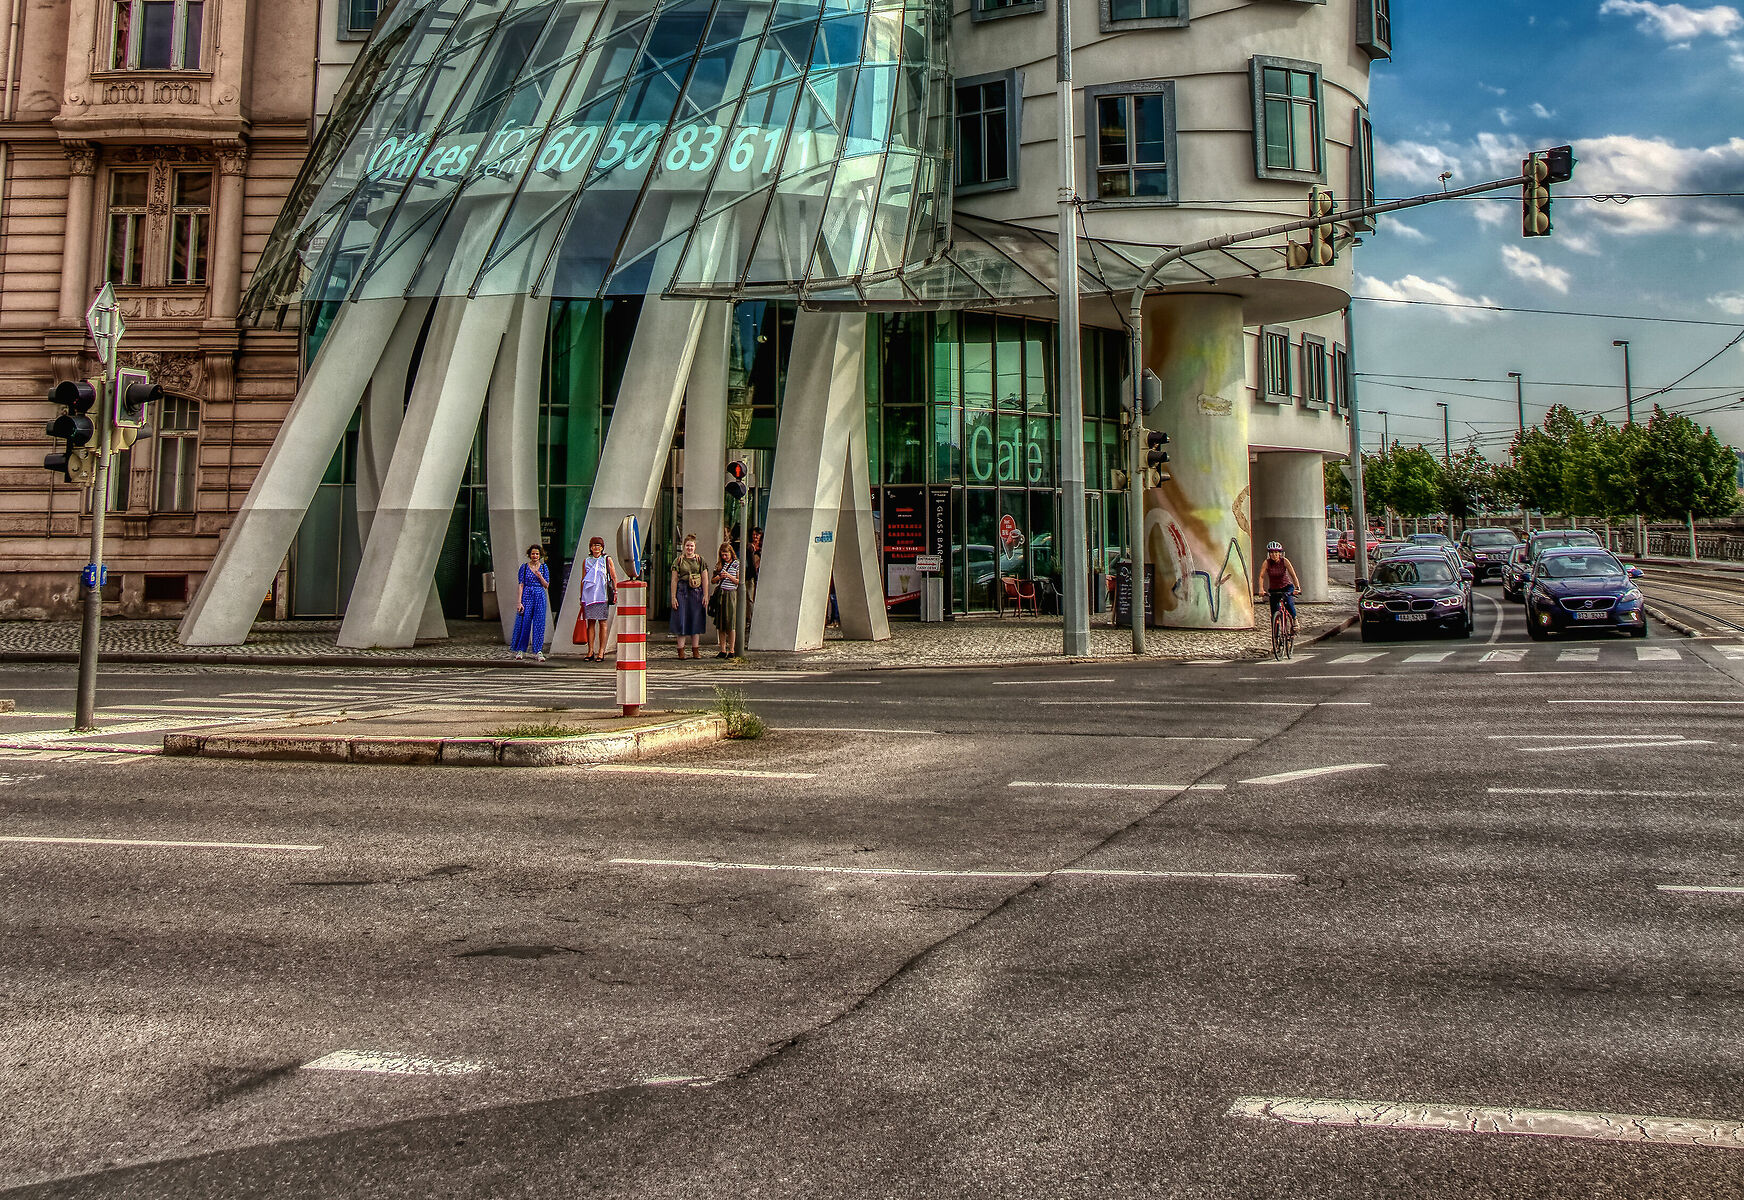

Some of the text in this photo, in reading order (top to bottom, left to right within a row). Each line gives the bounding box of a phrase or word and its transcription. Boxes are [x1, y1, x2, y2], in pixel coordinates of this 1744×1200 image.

[365, 132, 478, 183] Offices
[486, 119, 544, 155] for
[534, 125, 599, 173] 60
[596, 123, 661, 171] 50
[665, 124, 723, 172] 83
[475, 154, 529, 177] rent
[970, 425, 1043, 483] Café
